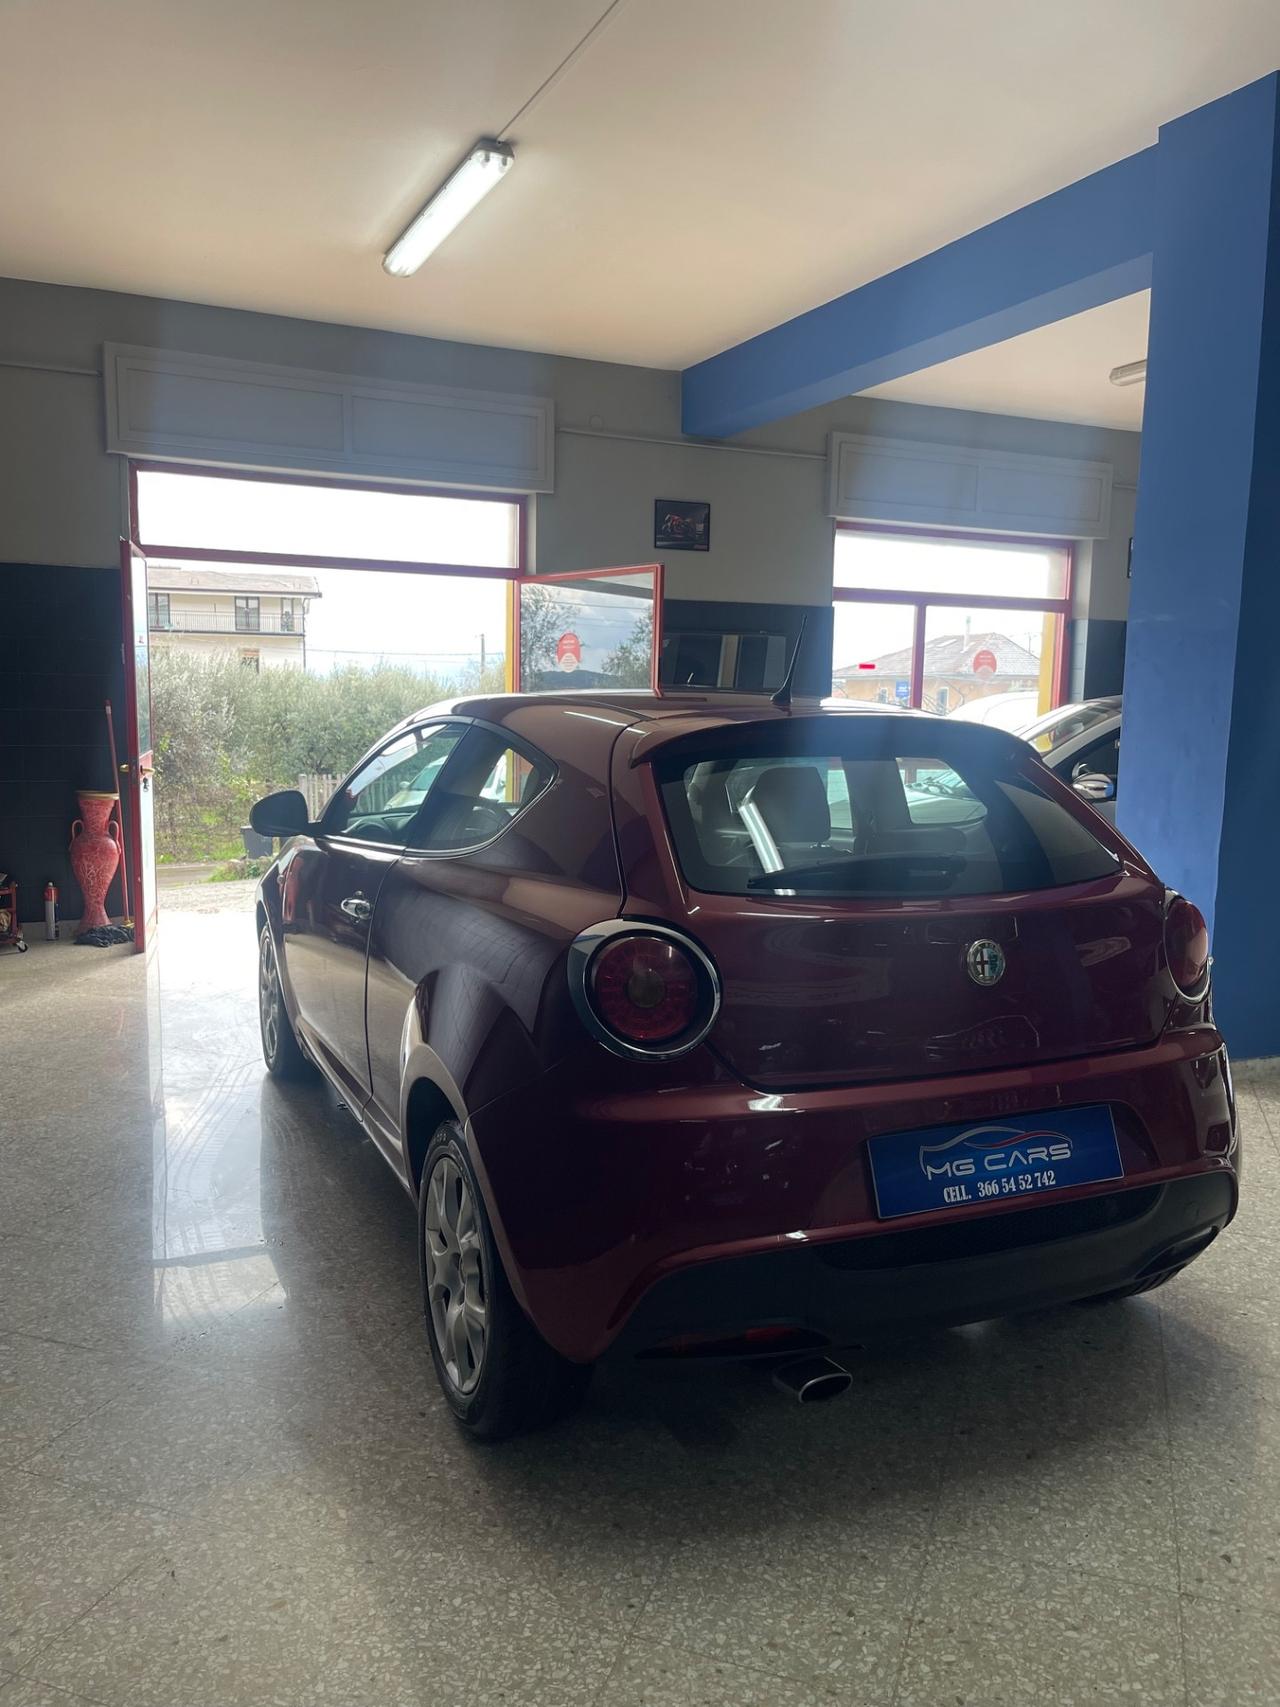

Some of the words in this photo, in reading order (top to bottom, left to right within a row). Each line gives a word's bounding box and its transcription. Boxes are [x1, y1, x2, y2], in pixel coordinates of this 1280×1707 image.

[927, 1158, 975, 1180] MG
[984, 1143, 1071, 1171] CARS
[943, 1185, 972, 1203] CELL.
[977, 1180, 999, 1198] 366
[1002, 1177, 1016, 1193] 54
[1018, 1174, 1033, 1190] 52
[1034, 1170, 1056, 1187] 742
